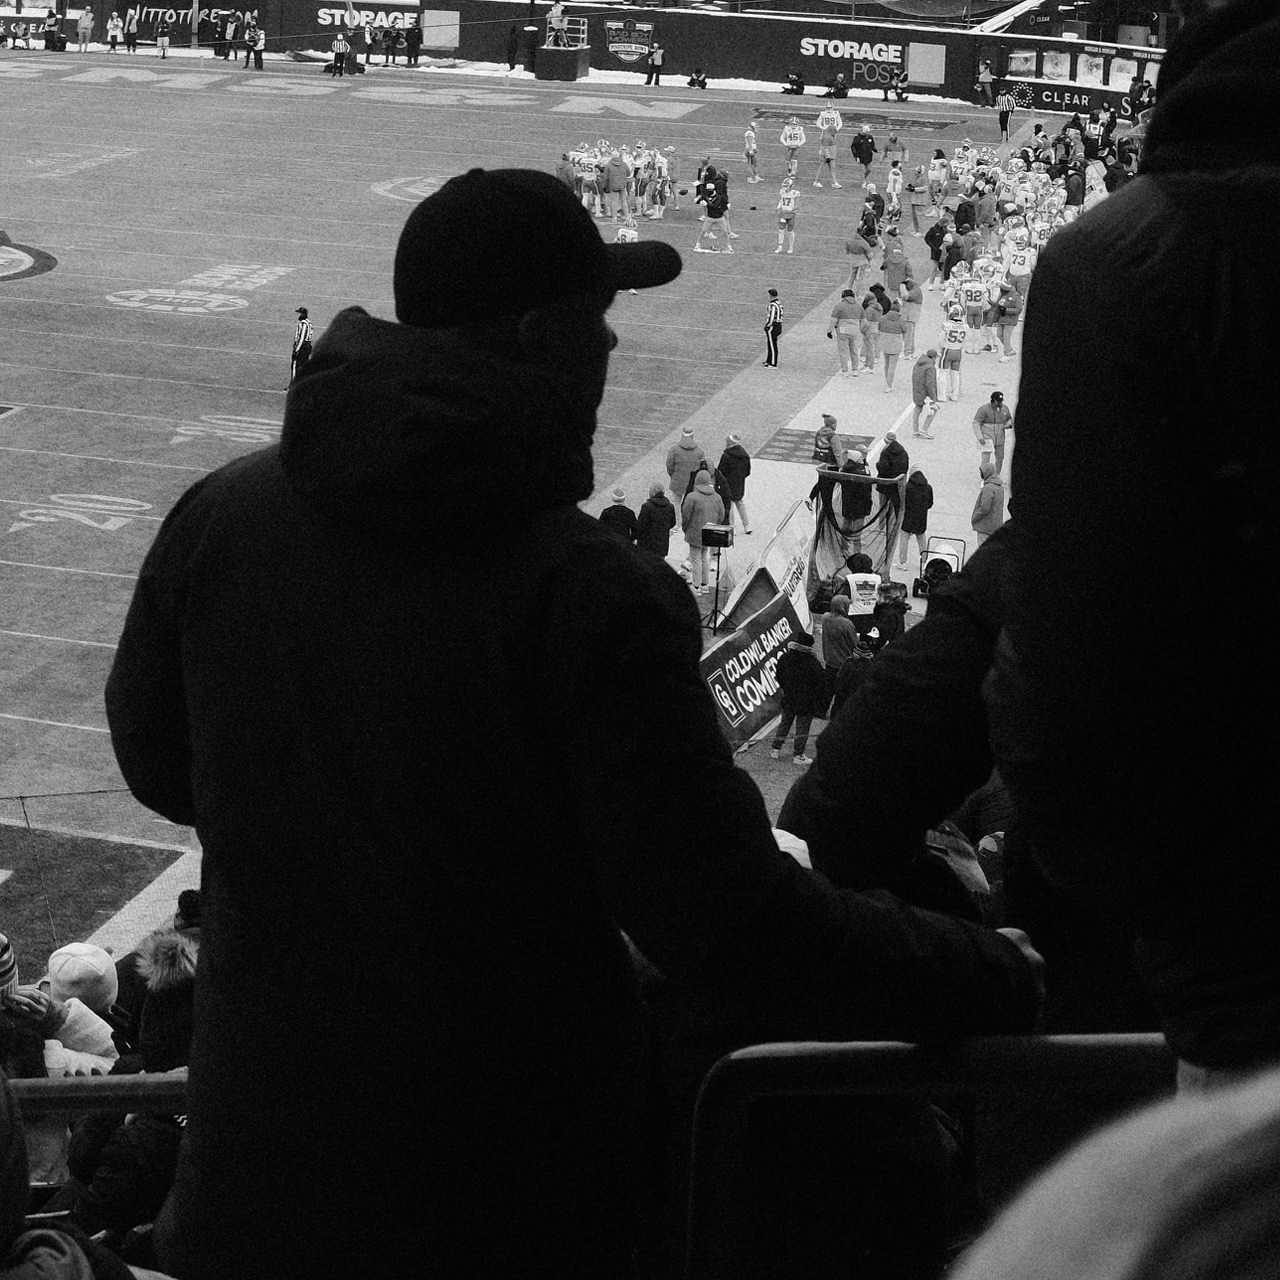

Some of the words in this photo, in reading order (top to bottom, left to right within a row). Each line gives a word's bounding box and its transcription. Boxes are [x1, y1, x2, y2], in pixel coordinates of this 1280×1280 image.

[317, 8, 418, 29] STORAGE
[800, 37, 902, 63] STORAGE
[1042, 91, 1089, 108] CLEAR
[1011, 255, 1026, 266] 73
[947, 330, 967, 344] 53
[760, 616, 793, 652] BANKER
